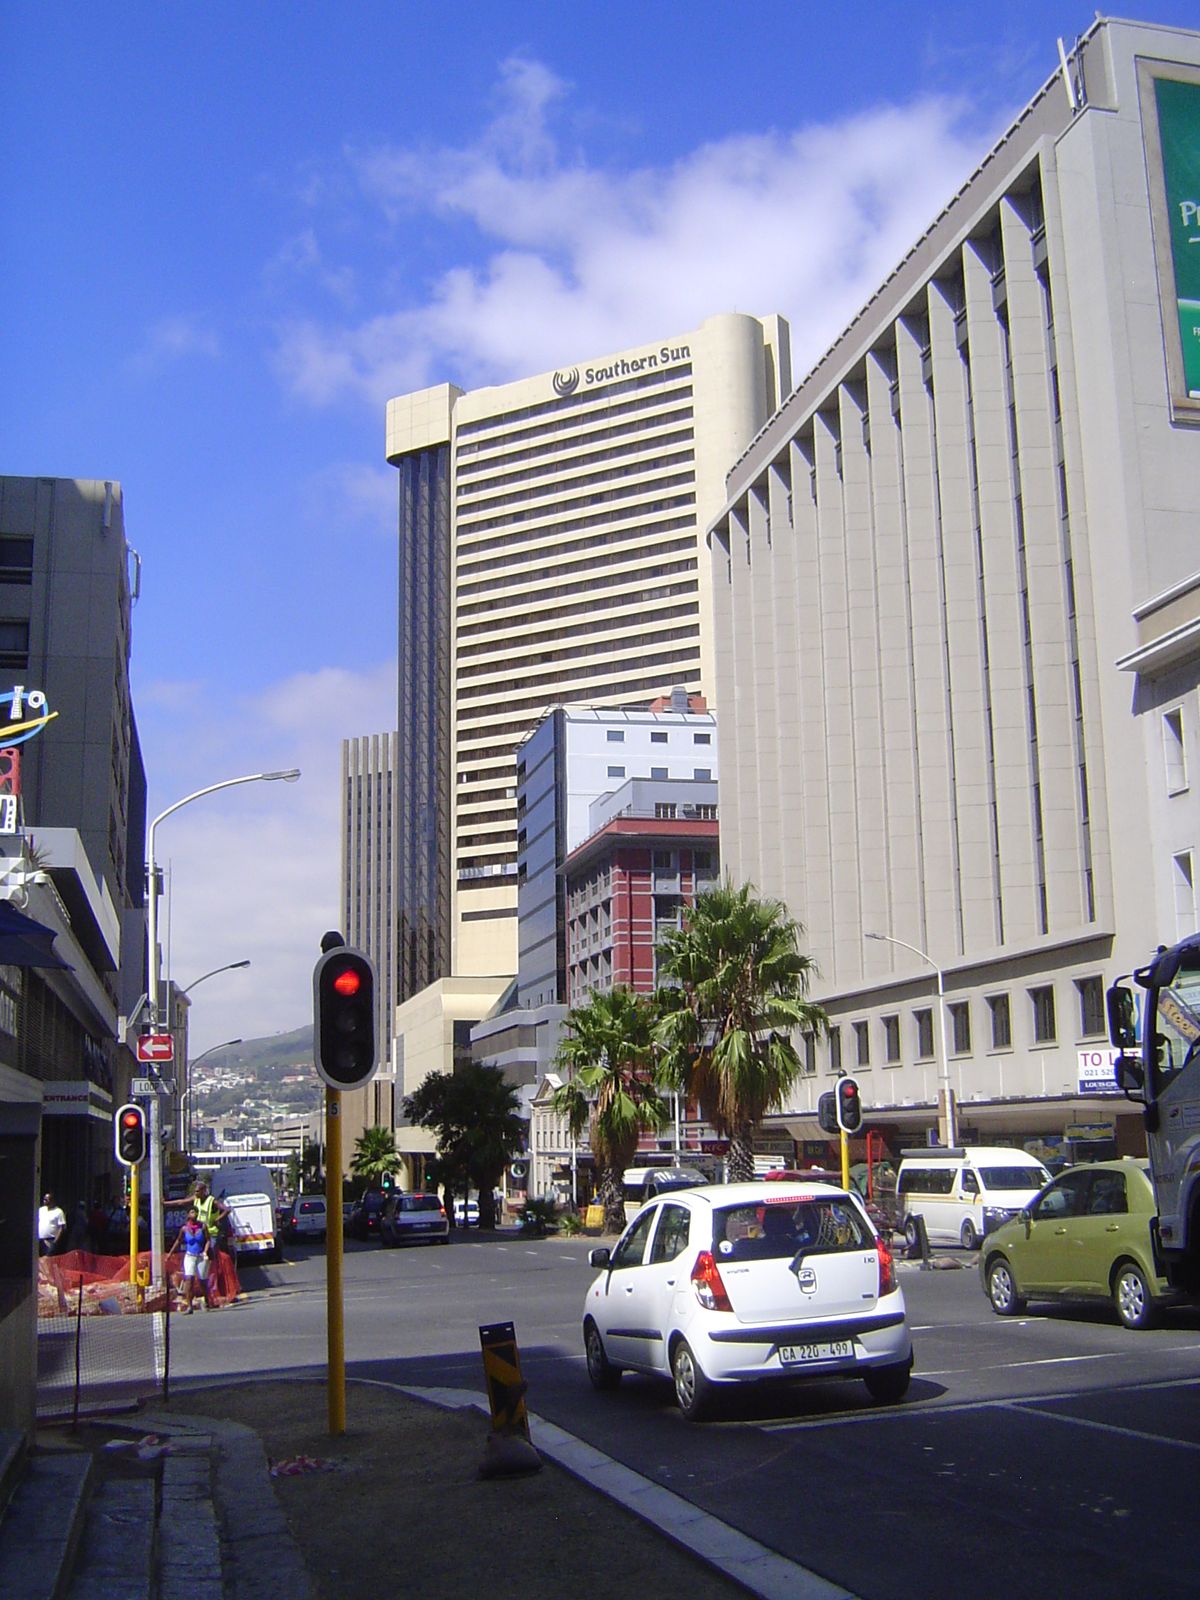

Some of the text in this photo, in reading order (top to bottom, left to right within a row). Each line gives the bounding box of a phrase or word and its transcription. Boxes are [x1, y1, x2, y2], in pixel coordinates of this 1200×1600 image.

[585, 345, 691, 384] Southern Sun
[1080, 1052, 1102, 1067] TO
[704, 1143, 722, 1152] KFC
[782, 1342, 848, 1361] CA 220 499
